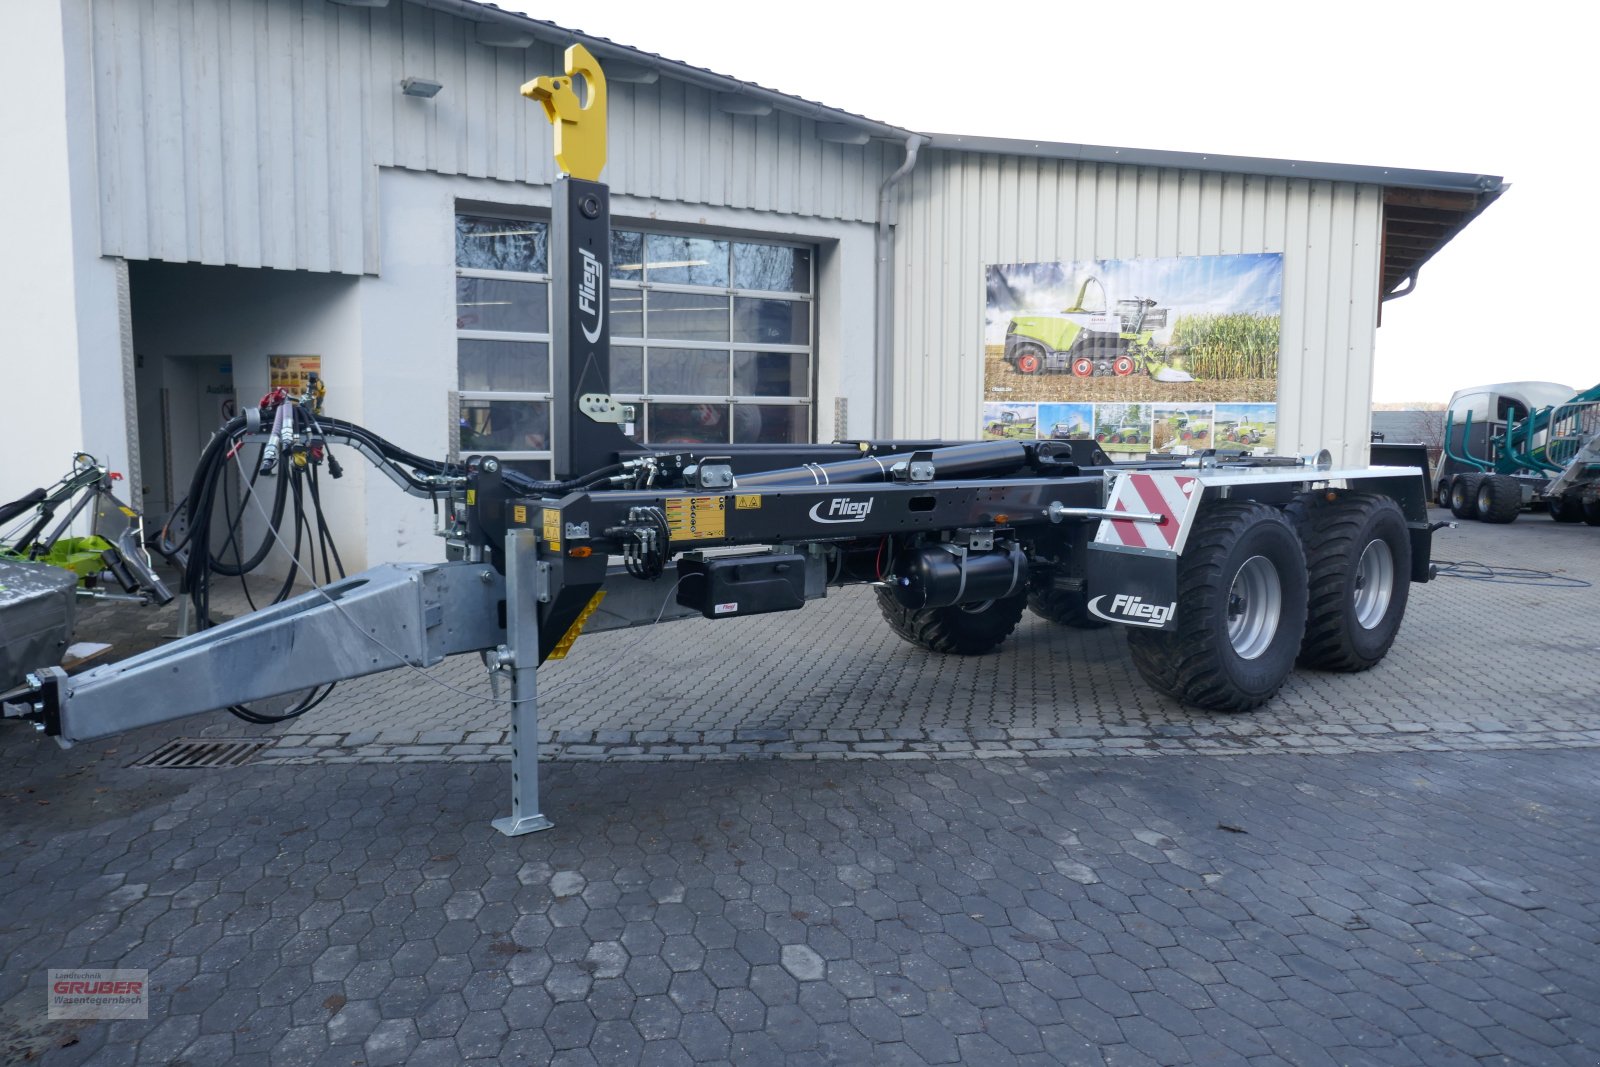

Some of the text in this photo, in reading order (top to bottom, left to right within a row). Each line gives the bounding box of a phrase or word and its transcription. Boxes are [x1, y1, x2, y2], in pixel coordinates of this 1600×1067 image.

[579, 248, 600, 316] Fliegl
[828, 496, 874, 519] Fliegl
[1110, 594, 1177, 624] Fliegl
